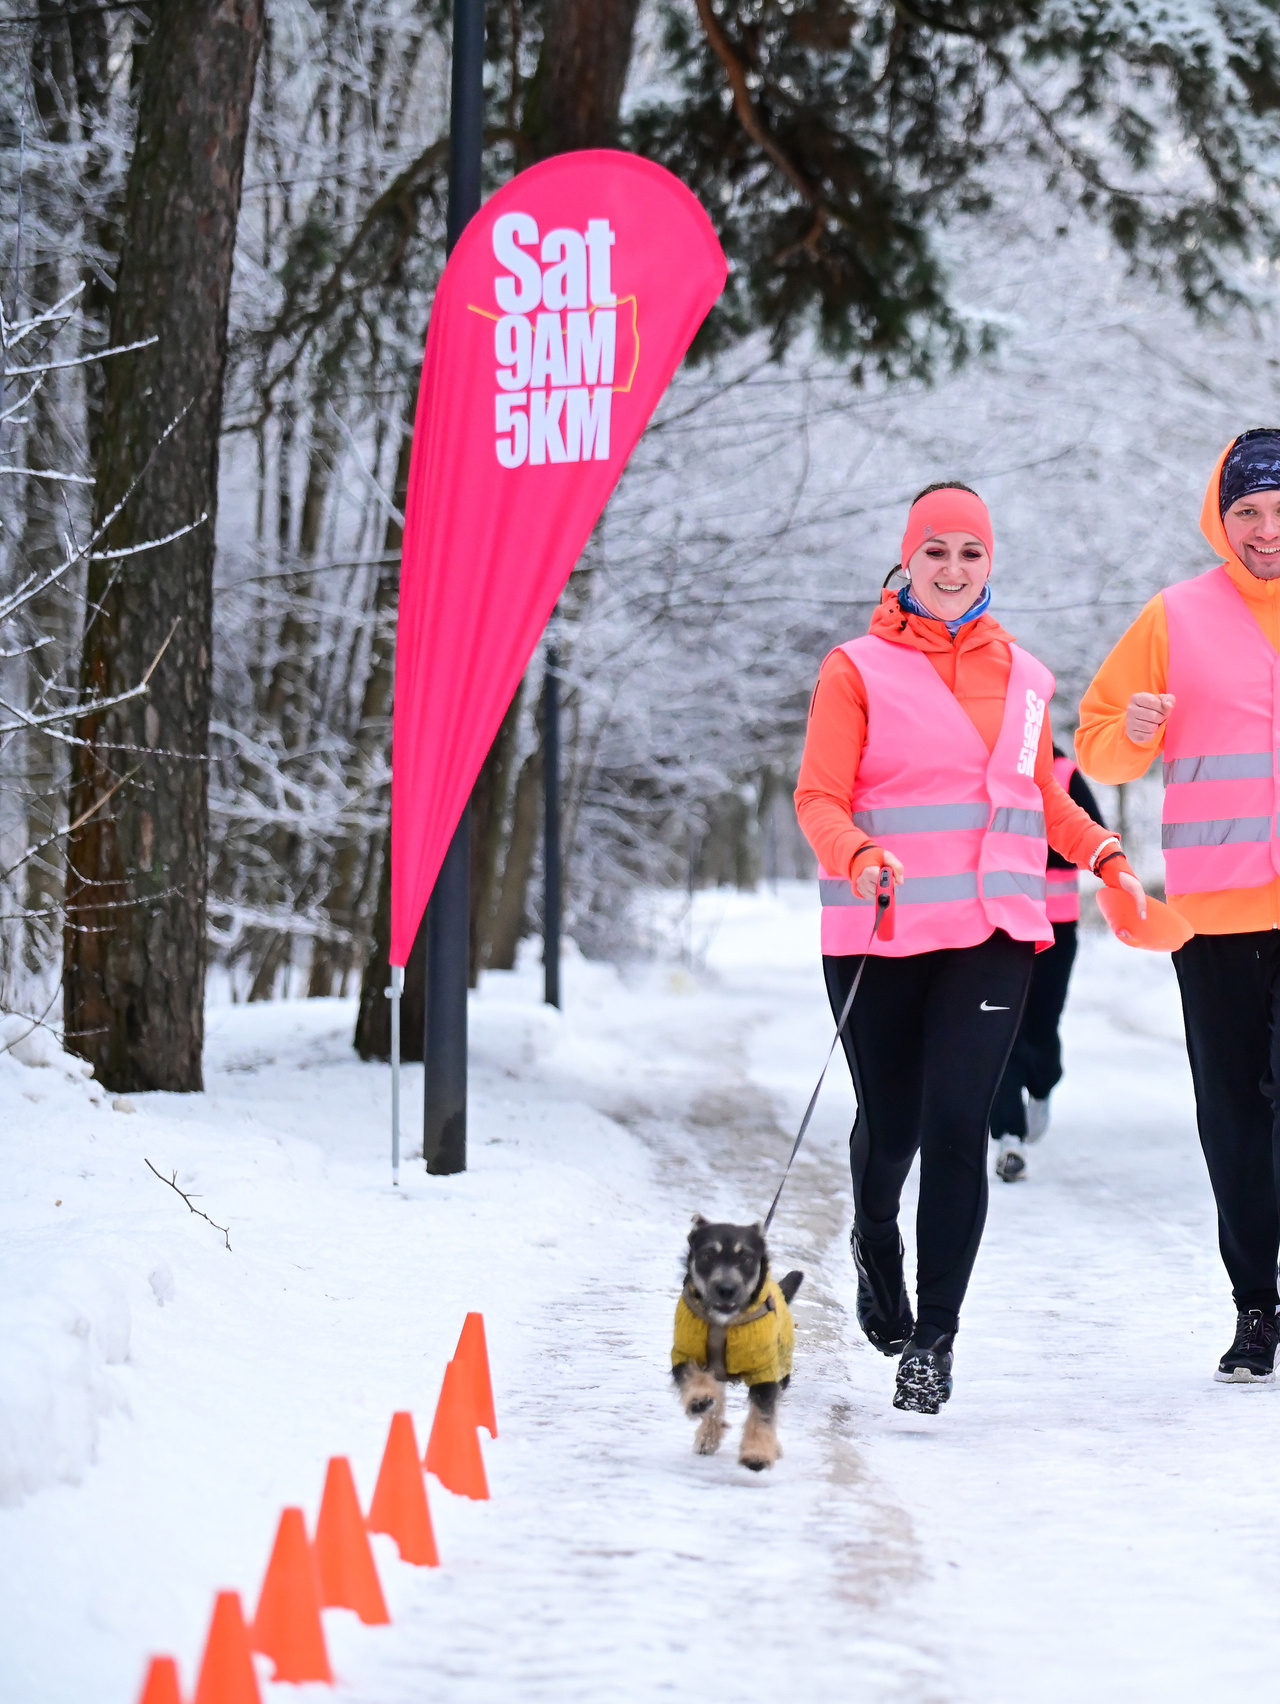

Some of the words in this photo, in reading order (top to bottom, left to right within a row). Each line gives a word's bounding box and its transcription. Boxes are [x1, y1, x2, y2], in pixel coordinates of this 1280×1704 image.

[492, 211, 617, 315] Sat
[494, 310, 617, 392] 9AM
[495, 387, 613, 469] 5KM
[1023, 721, 1042, 753] 9A
[1025, 688, 1046, 728] Sa
[1016, 747, 1038, 779] 5K
